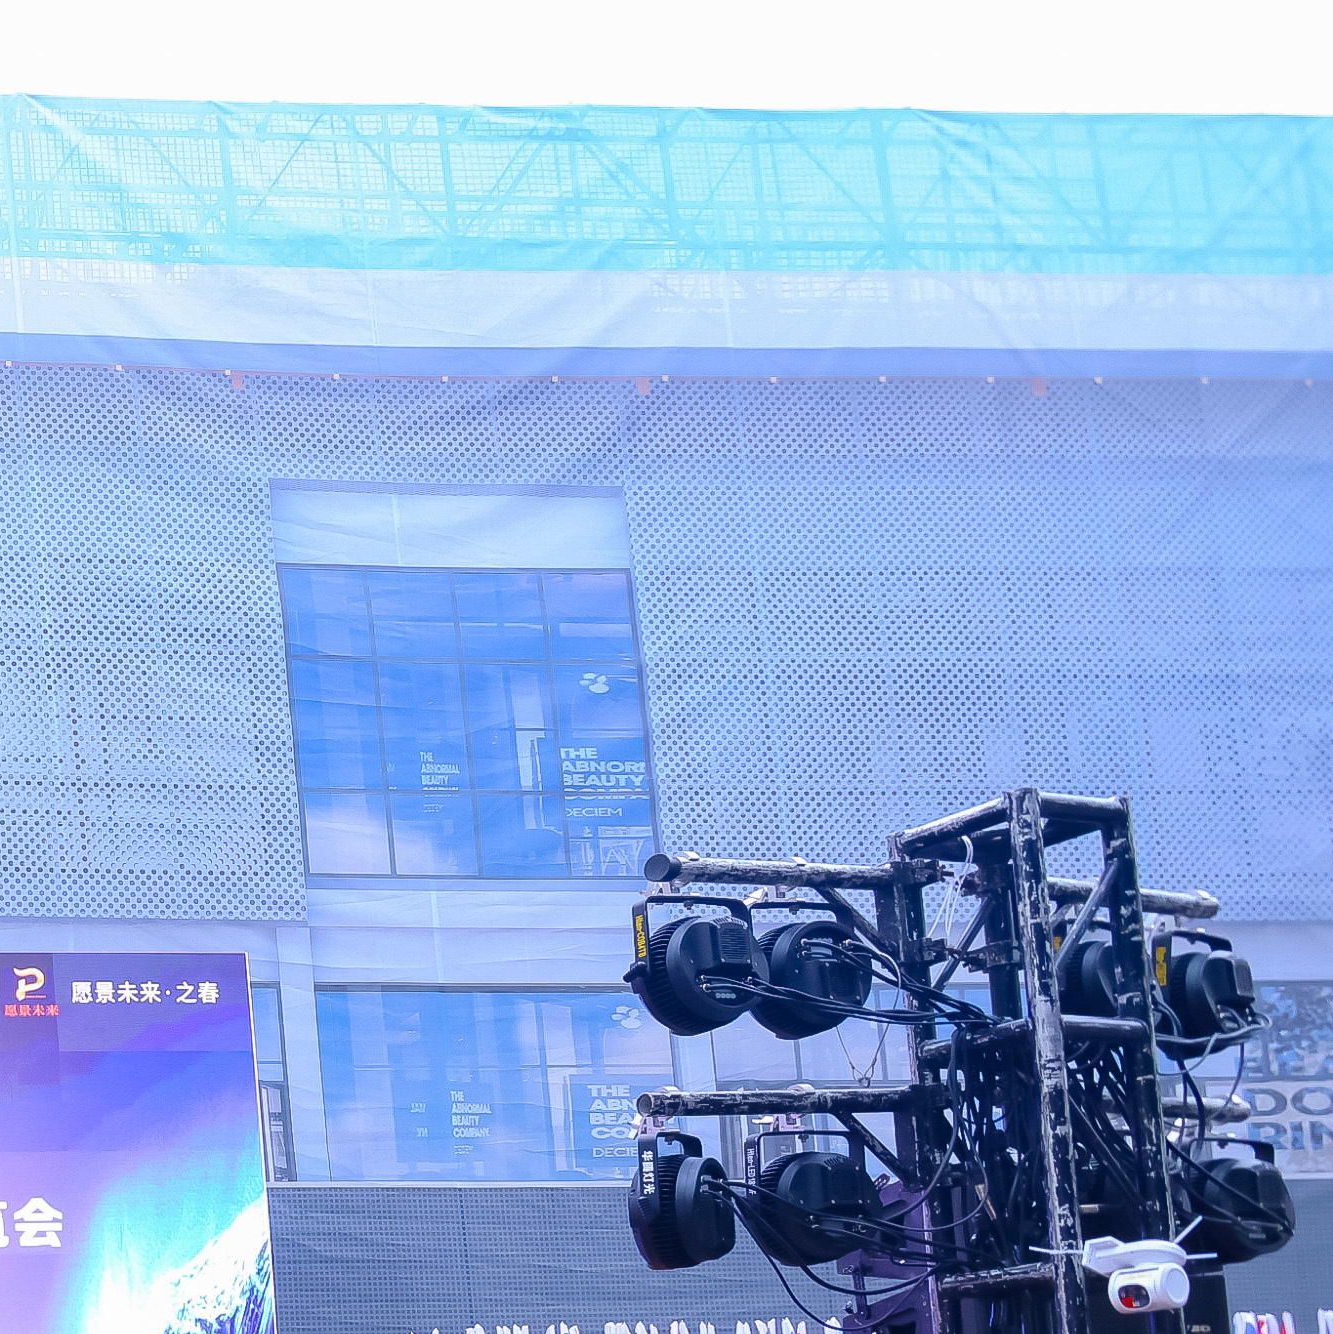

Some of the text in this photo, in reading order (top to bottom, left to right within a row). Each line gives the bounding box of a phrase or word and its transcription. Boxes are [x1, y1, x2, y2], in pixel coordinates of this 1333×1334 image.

[560, 747, 598, 759] THE
[563, 774, 646, 787] BEAUTY
[71, 980, 221, 1005] 愿景未来·之春
[587, 1084, 630, 1096] THE
[593, 1147, 638, 1158] DECIE
